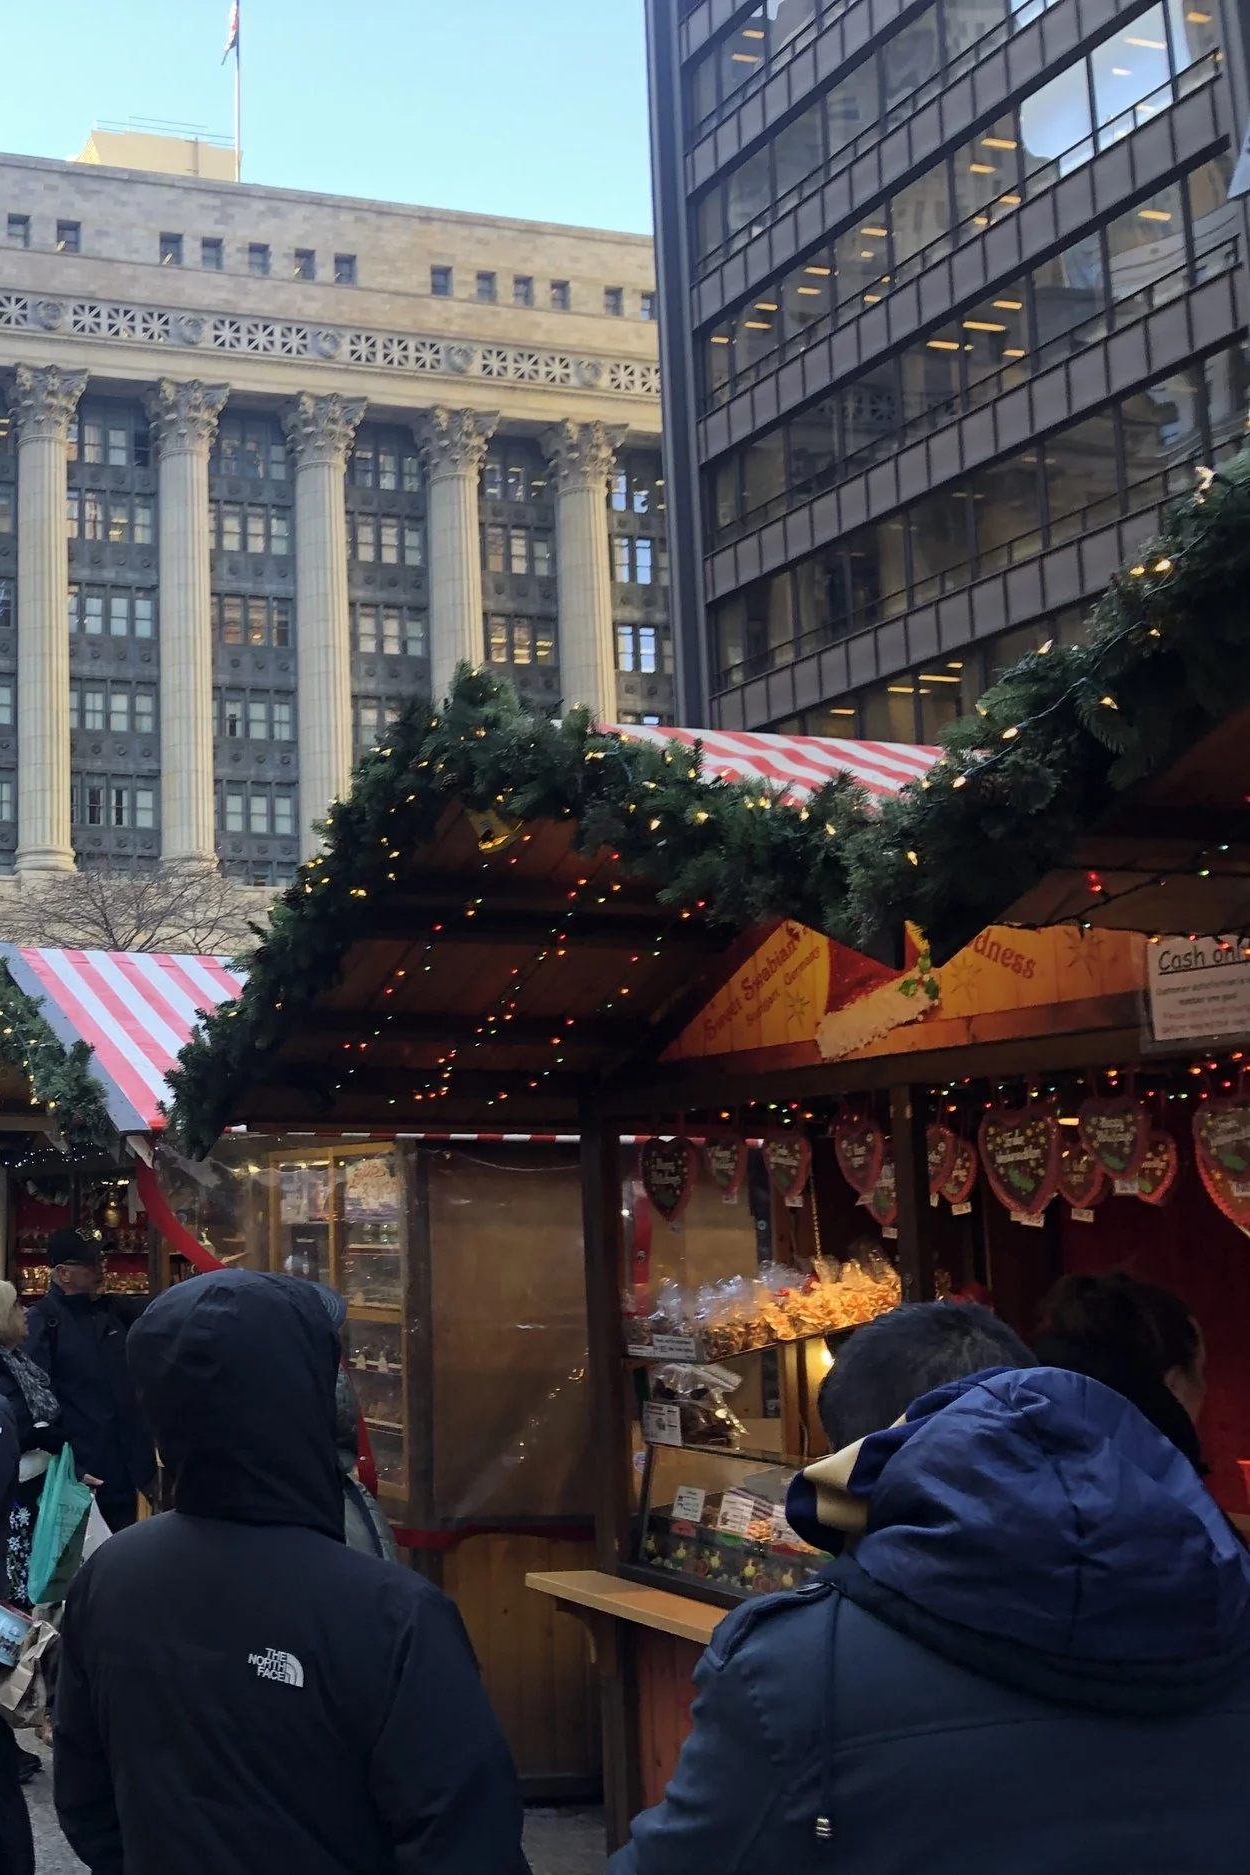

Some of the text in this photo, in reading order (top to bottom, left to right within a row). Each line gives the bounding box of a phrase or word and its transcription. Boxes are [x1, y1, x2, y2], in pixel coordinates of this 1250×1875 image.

[1158, 945, 1206, 971] Cash
[703, 938, 798, 1040] Sweet Swabian
[248, 1654, 287, 1672] NORTH
[265, 1647, 287, 1662] THE
[257, 1666, 285, 1682] FACE
